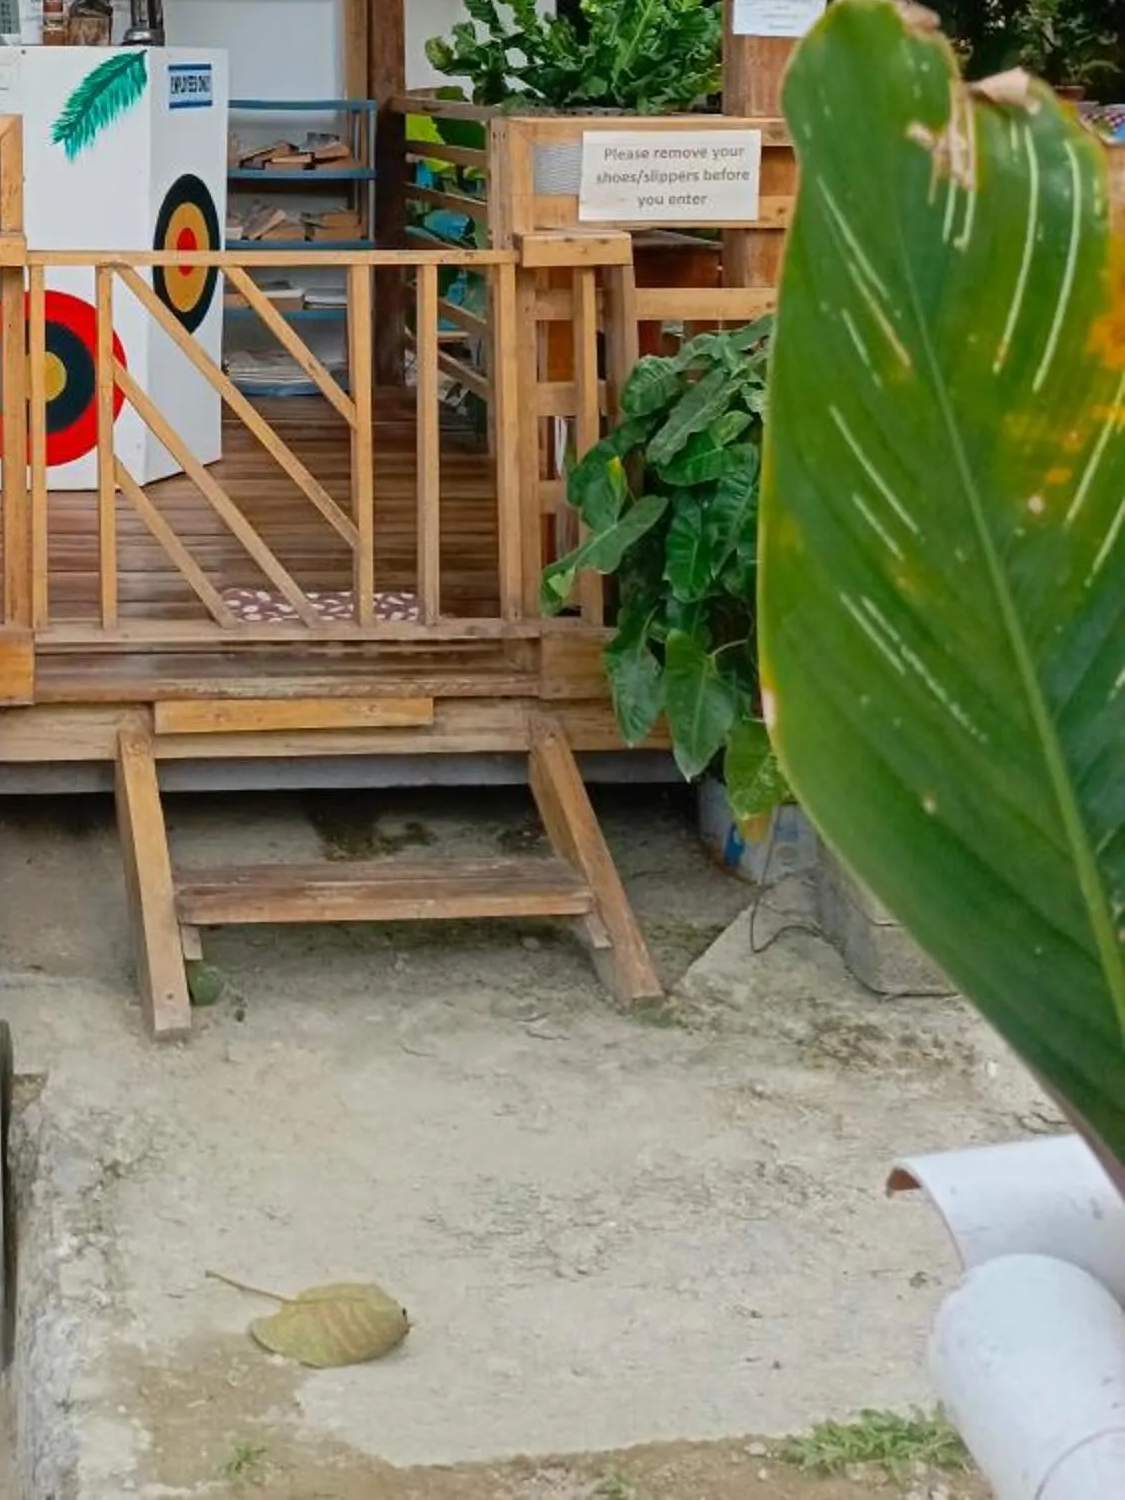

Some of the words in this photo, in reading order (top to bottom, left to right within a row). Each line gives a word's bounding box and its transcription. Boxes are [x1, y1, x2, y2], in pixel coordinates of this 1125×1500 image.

[604, 148, 650, 161] Please
[654, 149, 708, 159] remove
[713, 147, 746, 161] your
[596, 170, 700, 185] shoes/slippers
[703, 168, 751, 181] before
[637, 194, 664, 208] you
[668, 195, 708, 206] enter
